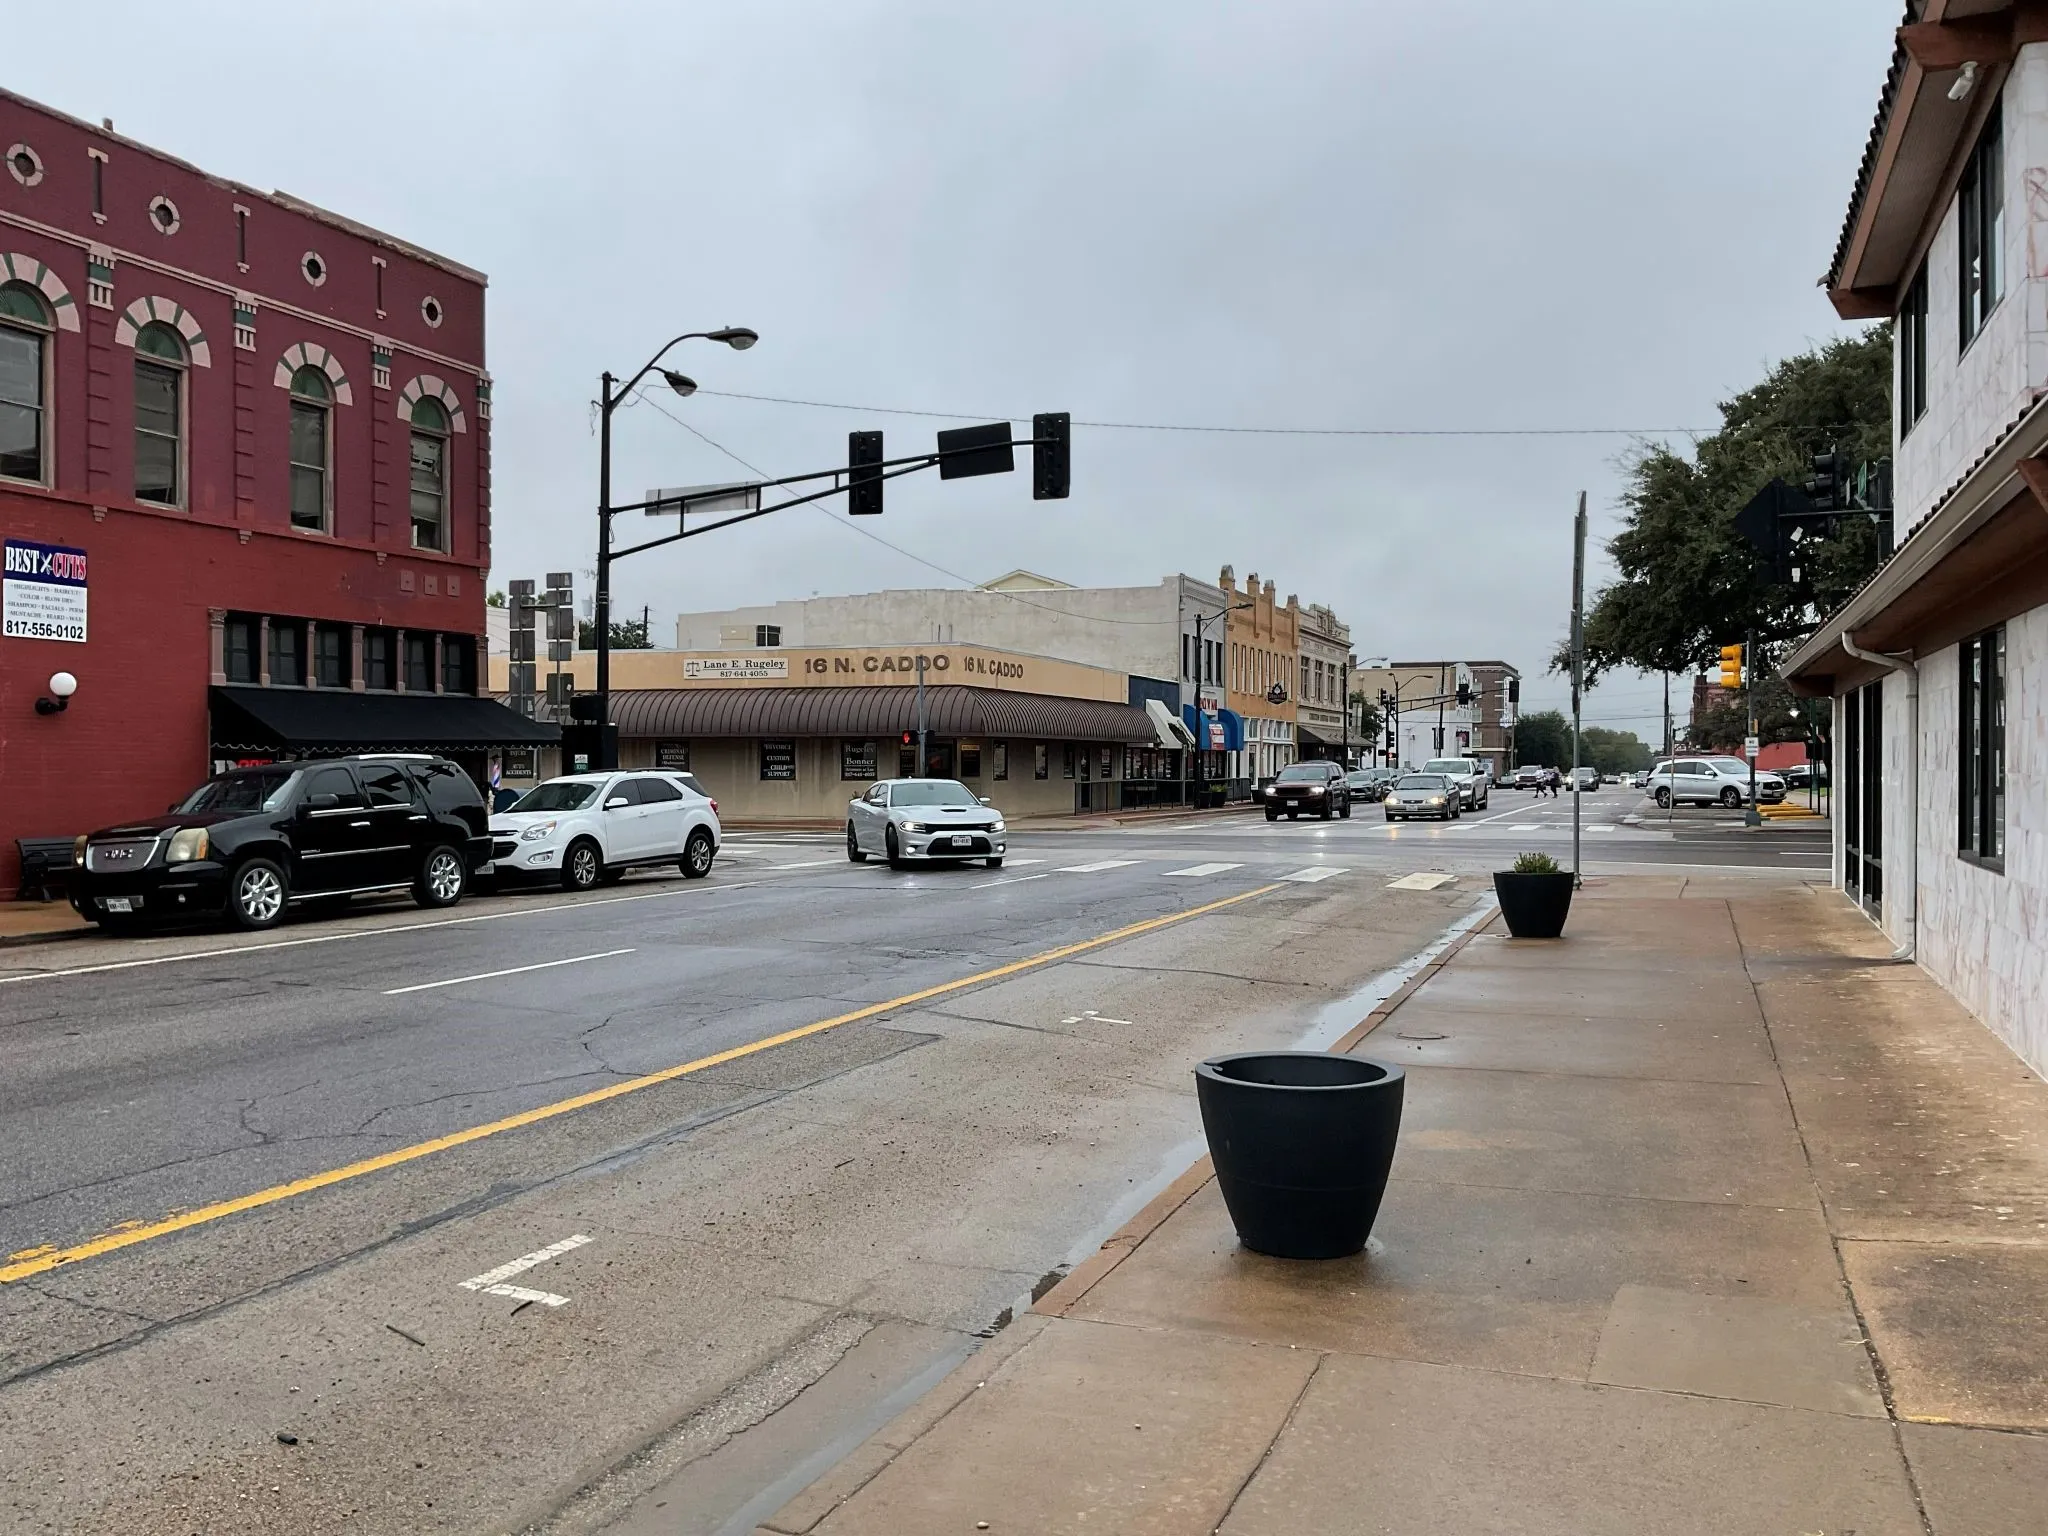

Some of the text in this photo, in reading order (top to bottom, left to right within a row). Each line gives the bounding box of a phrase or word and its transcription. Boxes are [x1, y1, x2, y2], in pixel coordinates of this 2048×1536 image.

[5, 546, 87, 580] BEST CUTS
[6, 619, 84, 640] 817-556-0102
[703, 660, 727, 669] Lane
[745, 659, 785, 669] Rugeley
[805, 654, 950, 674] 16 N. CADDO
[963, 655, 1024, 679] 16 N. CADDO
[846, 757, 875, 765] Bonner
